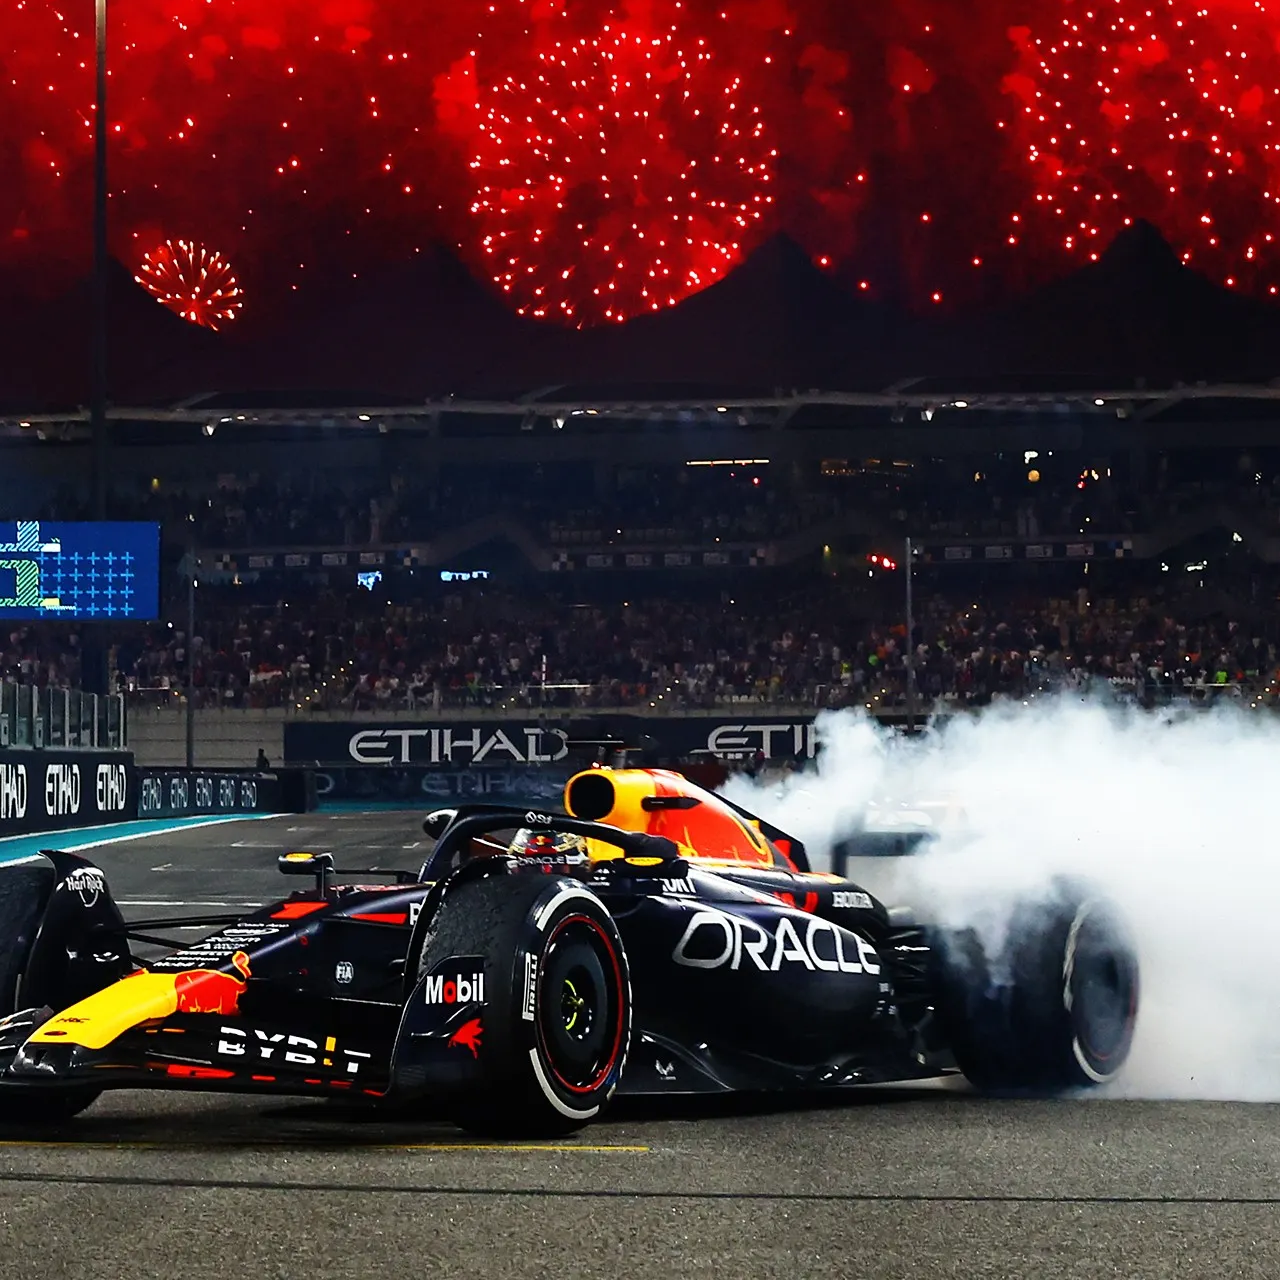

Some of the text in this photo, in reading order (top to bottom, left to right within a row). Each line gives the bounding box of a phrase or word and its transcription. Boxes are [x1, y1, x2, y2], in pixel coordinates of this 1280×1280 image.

[349, 727, 570, 763] ETIHAD
[45, 764, 81, 816] ETIHAD
[96, 764, 127, 811] ETIHAD
[671, 911, 881, 975] ORACLE
[424, 972, 485, 1006] Mobil
